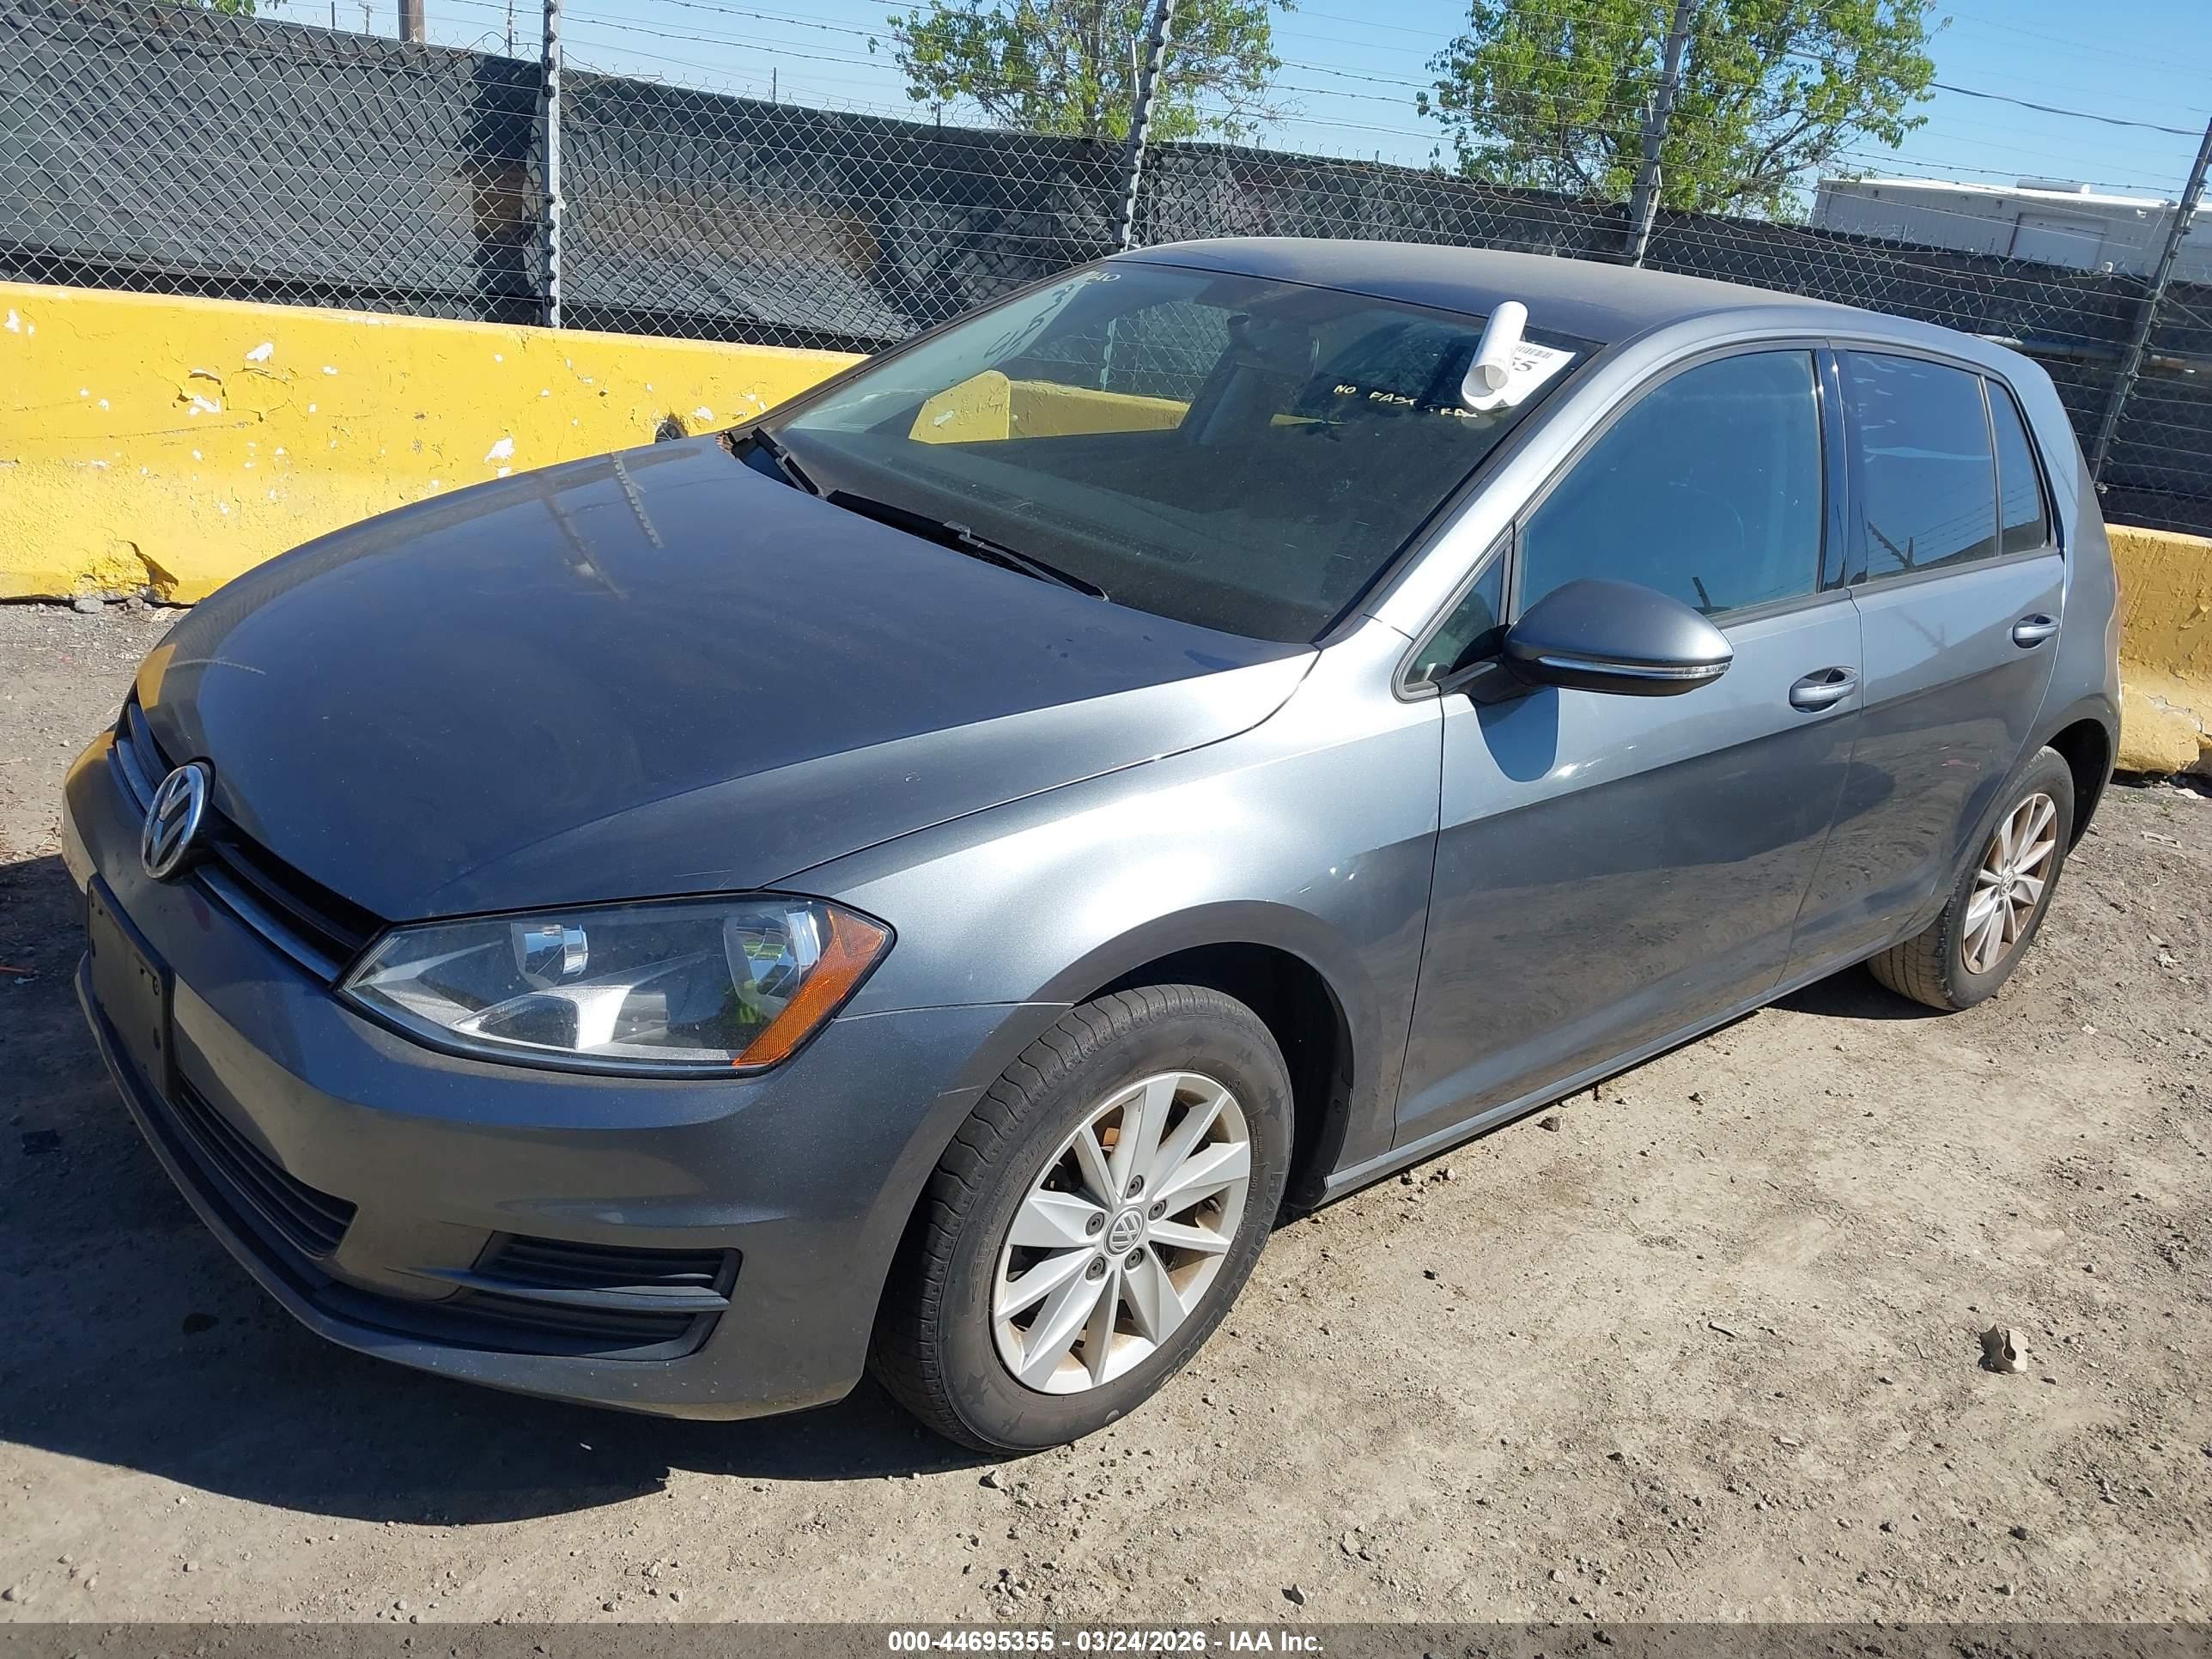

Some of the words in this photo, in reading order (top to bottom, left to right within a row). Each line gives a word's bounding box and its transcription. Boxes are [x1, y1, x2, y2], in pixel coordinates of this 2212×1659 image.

[1333, 384, 1357, 394] NO
[1369, 392, 1418, 406] FAST
[143, 766, 205, 878] VW
[1108, 1210, 1143, 1253] VW
